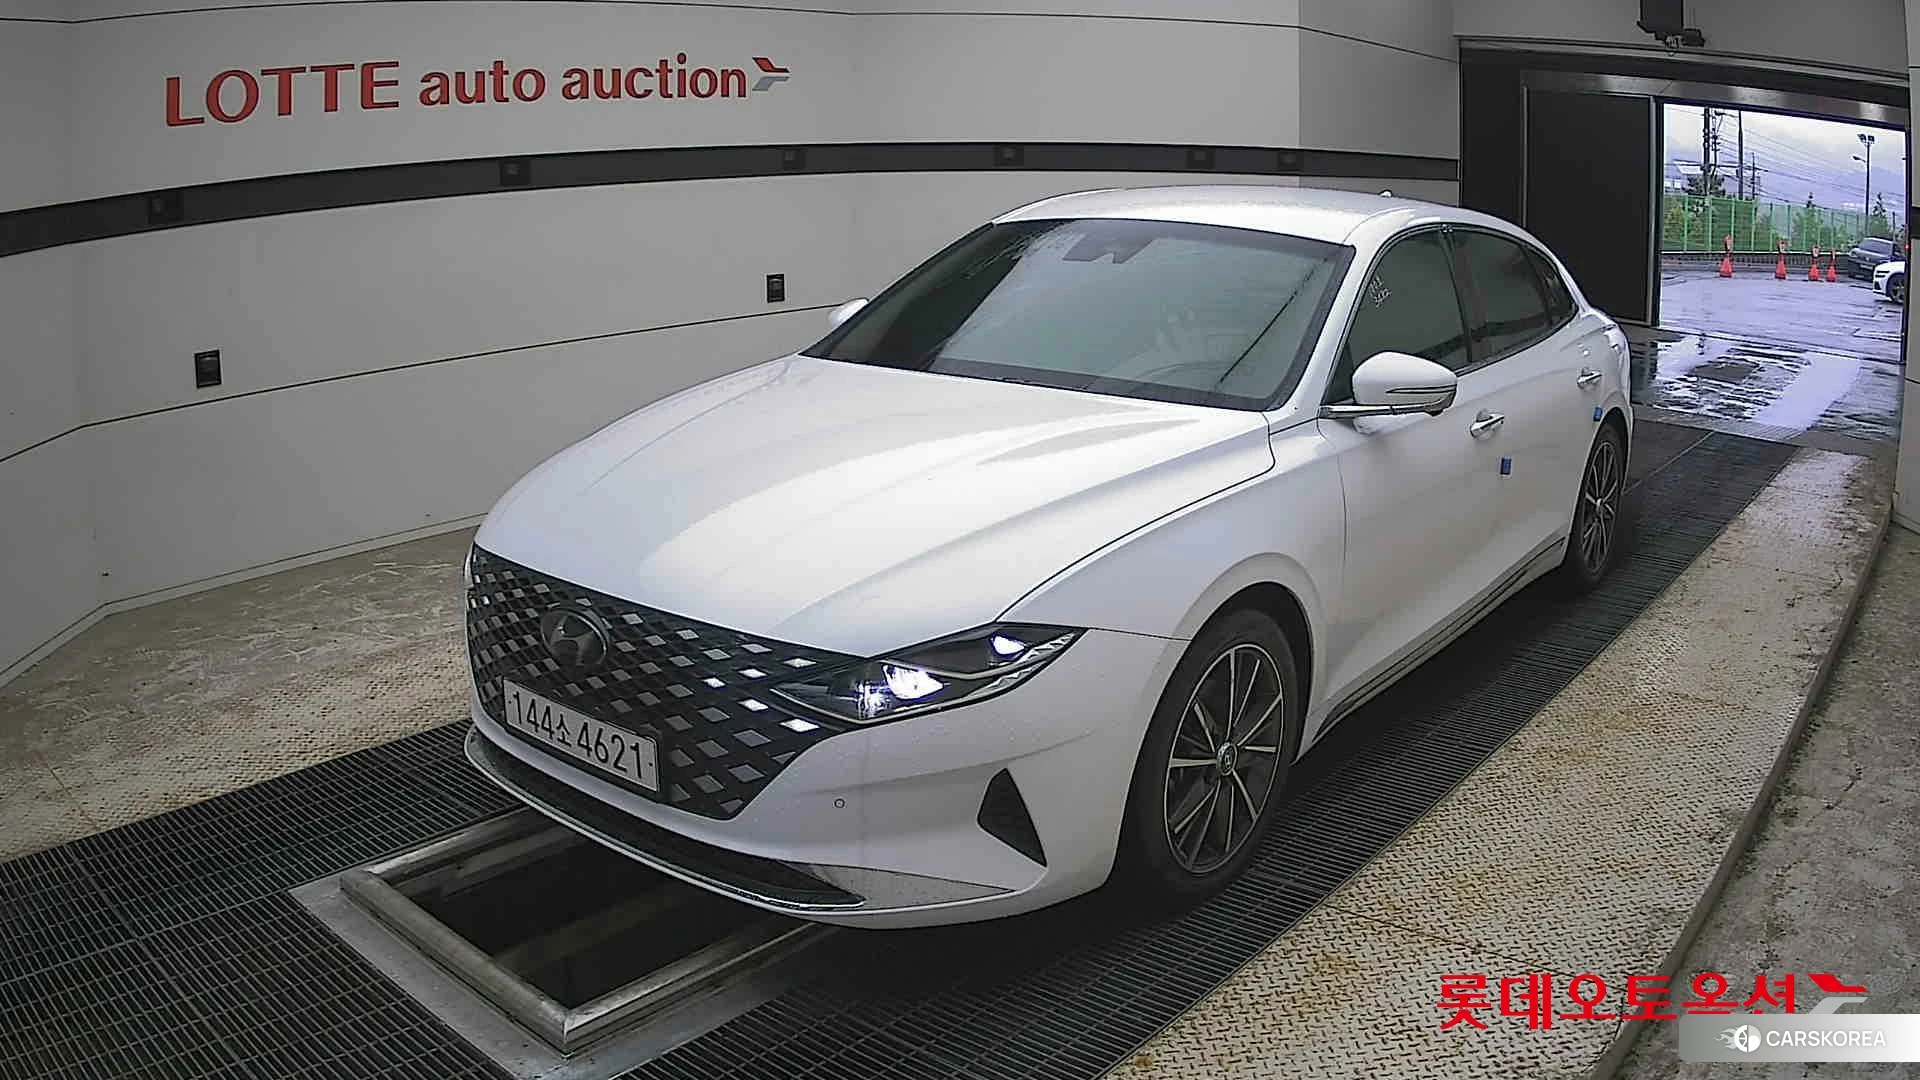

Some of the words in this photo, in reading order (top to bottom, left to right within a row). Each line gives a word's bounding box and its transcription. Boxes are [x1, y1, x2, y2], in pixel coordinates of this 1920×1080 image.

[165, 60, 400, 128] LOTTE
[419, 60, 546, 107] auto
[561, 52, 748, 101] auction
